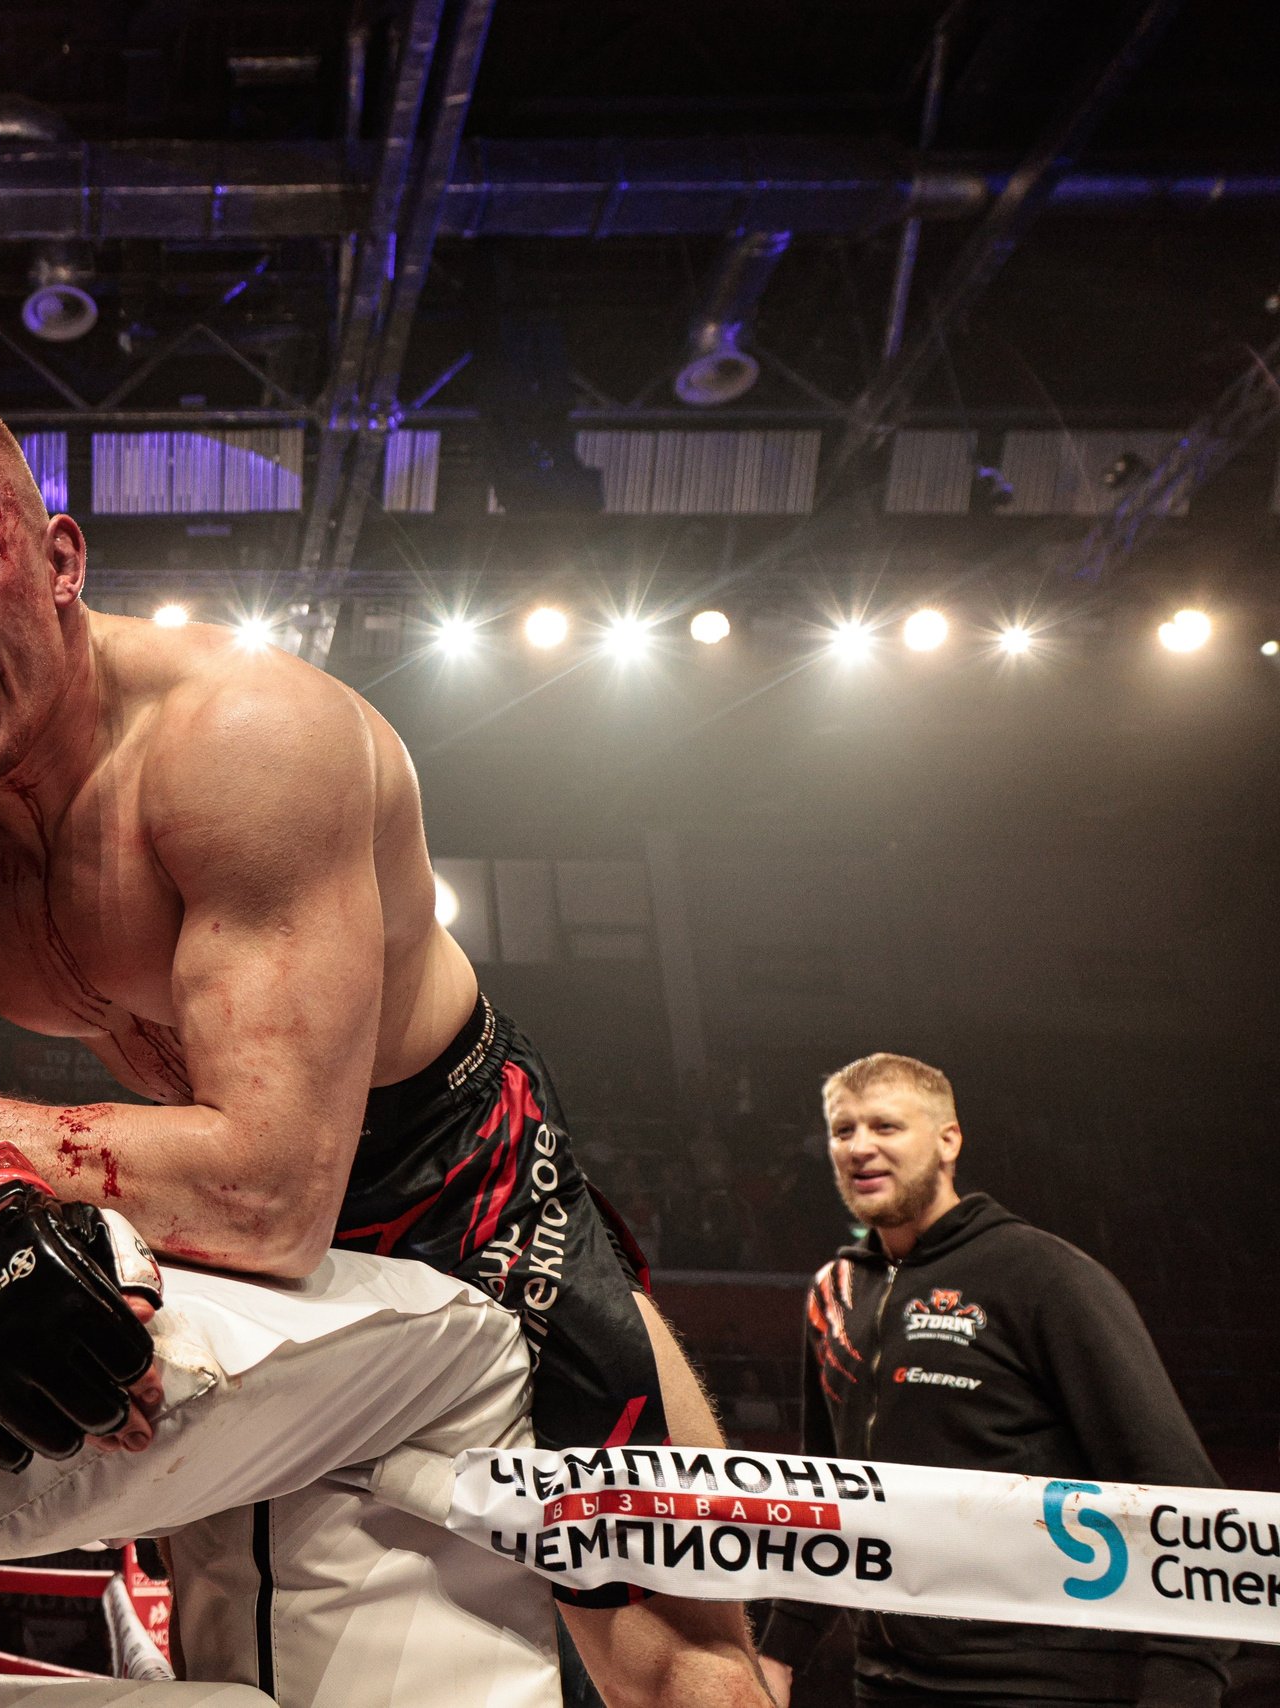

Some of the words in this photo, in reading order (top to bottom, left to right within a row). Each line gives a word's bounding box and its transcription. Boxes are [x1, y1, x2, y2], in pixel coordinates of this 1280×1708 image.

[906, 1313, 976, 1337] STORM
[491, 1448, 886, 1502] ЧЕМПИОНЫ
[553, 1493, 824, 1525] ВЫЗЫВАЮТ
[491, 1518, 893, 1582] ЧЕМПИОНОВ
